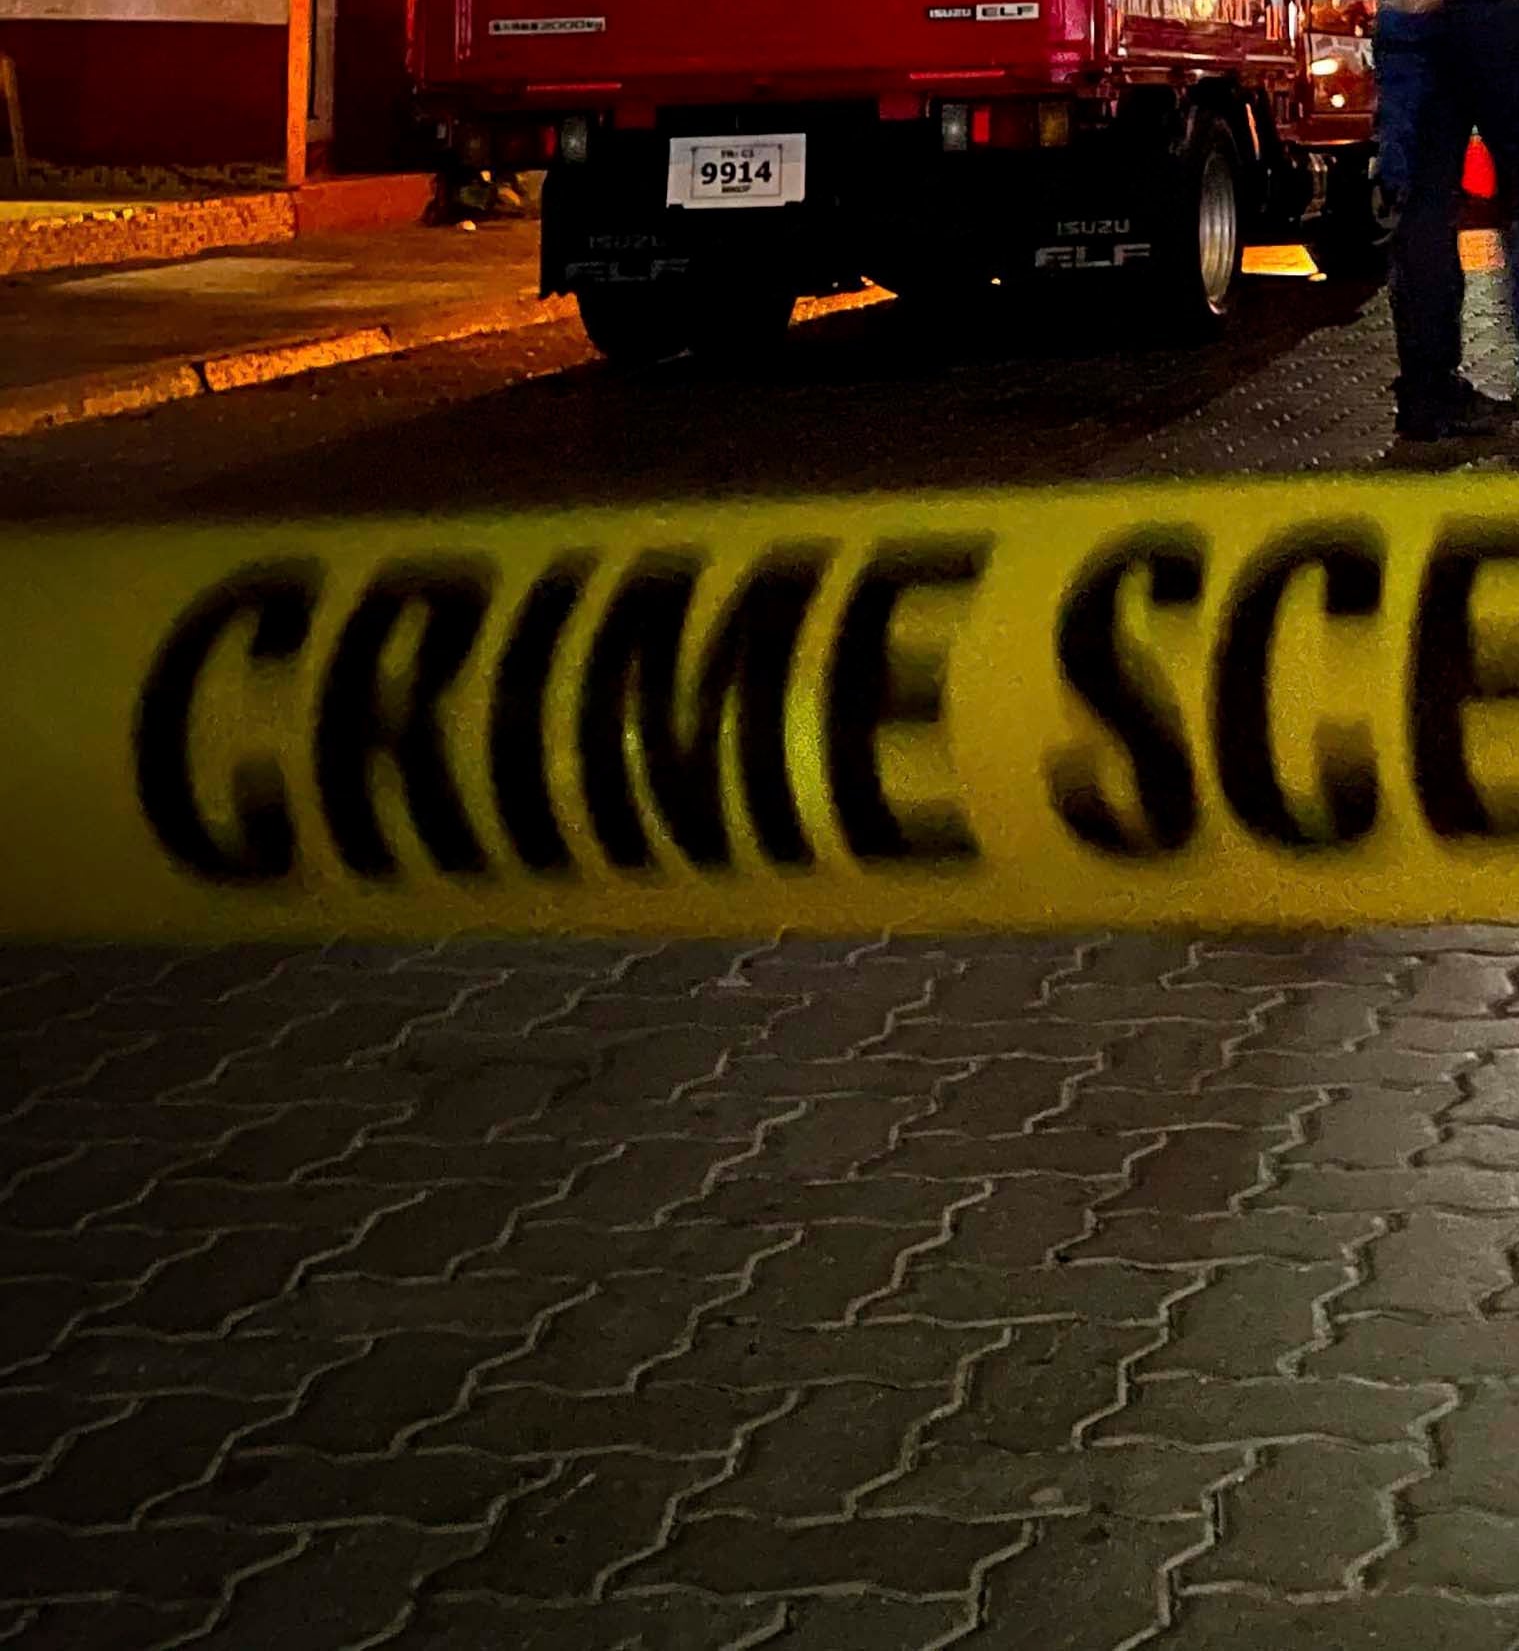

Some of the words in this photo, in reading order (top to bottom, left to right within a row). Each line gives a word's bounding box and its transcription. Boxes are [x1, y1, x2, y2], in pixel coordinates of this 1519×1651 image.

[928, 8, 972, 19] ISUZU
[982, 5, 1036, 18] ELF
[701, 160, 772, 186] 9914
[1056, 218, 1131, 237] ISUZU
[1034, 243, 1151, 268] ELF
[132, 530, 998, 882] CRIME
